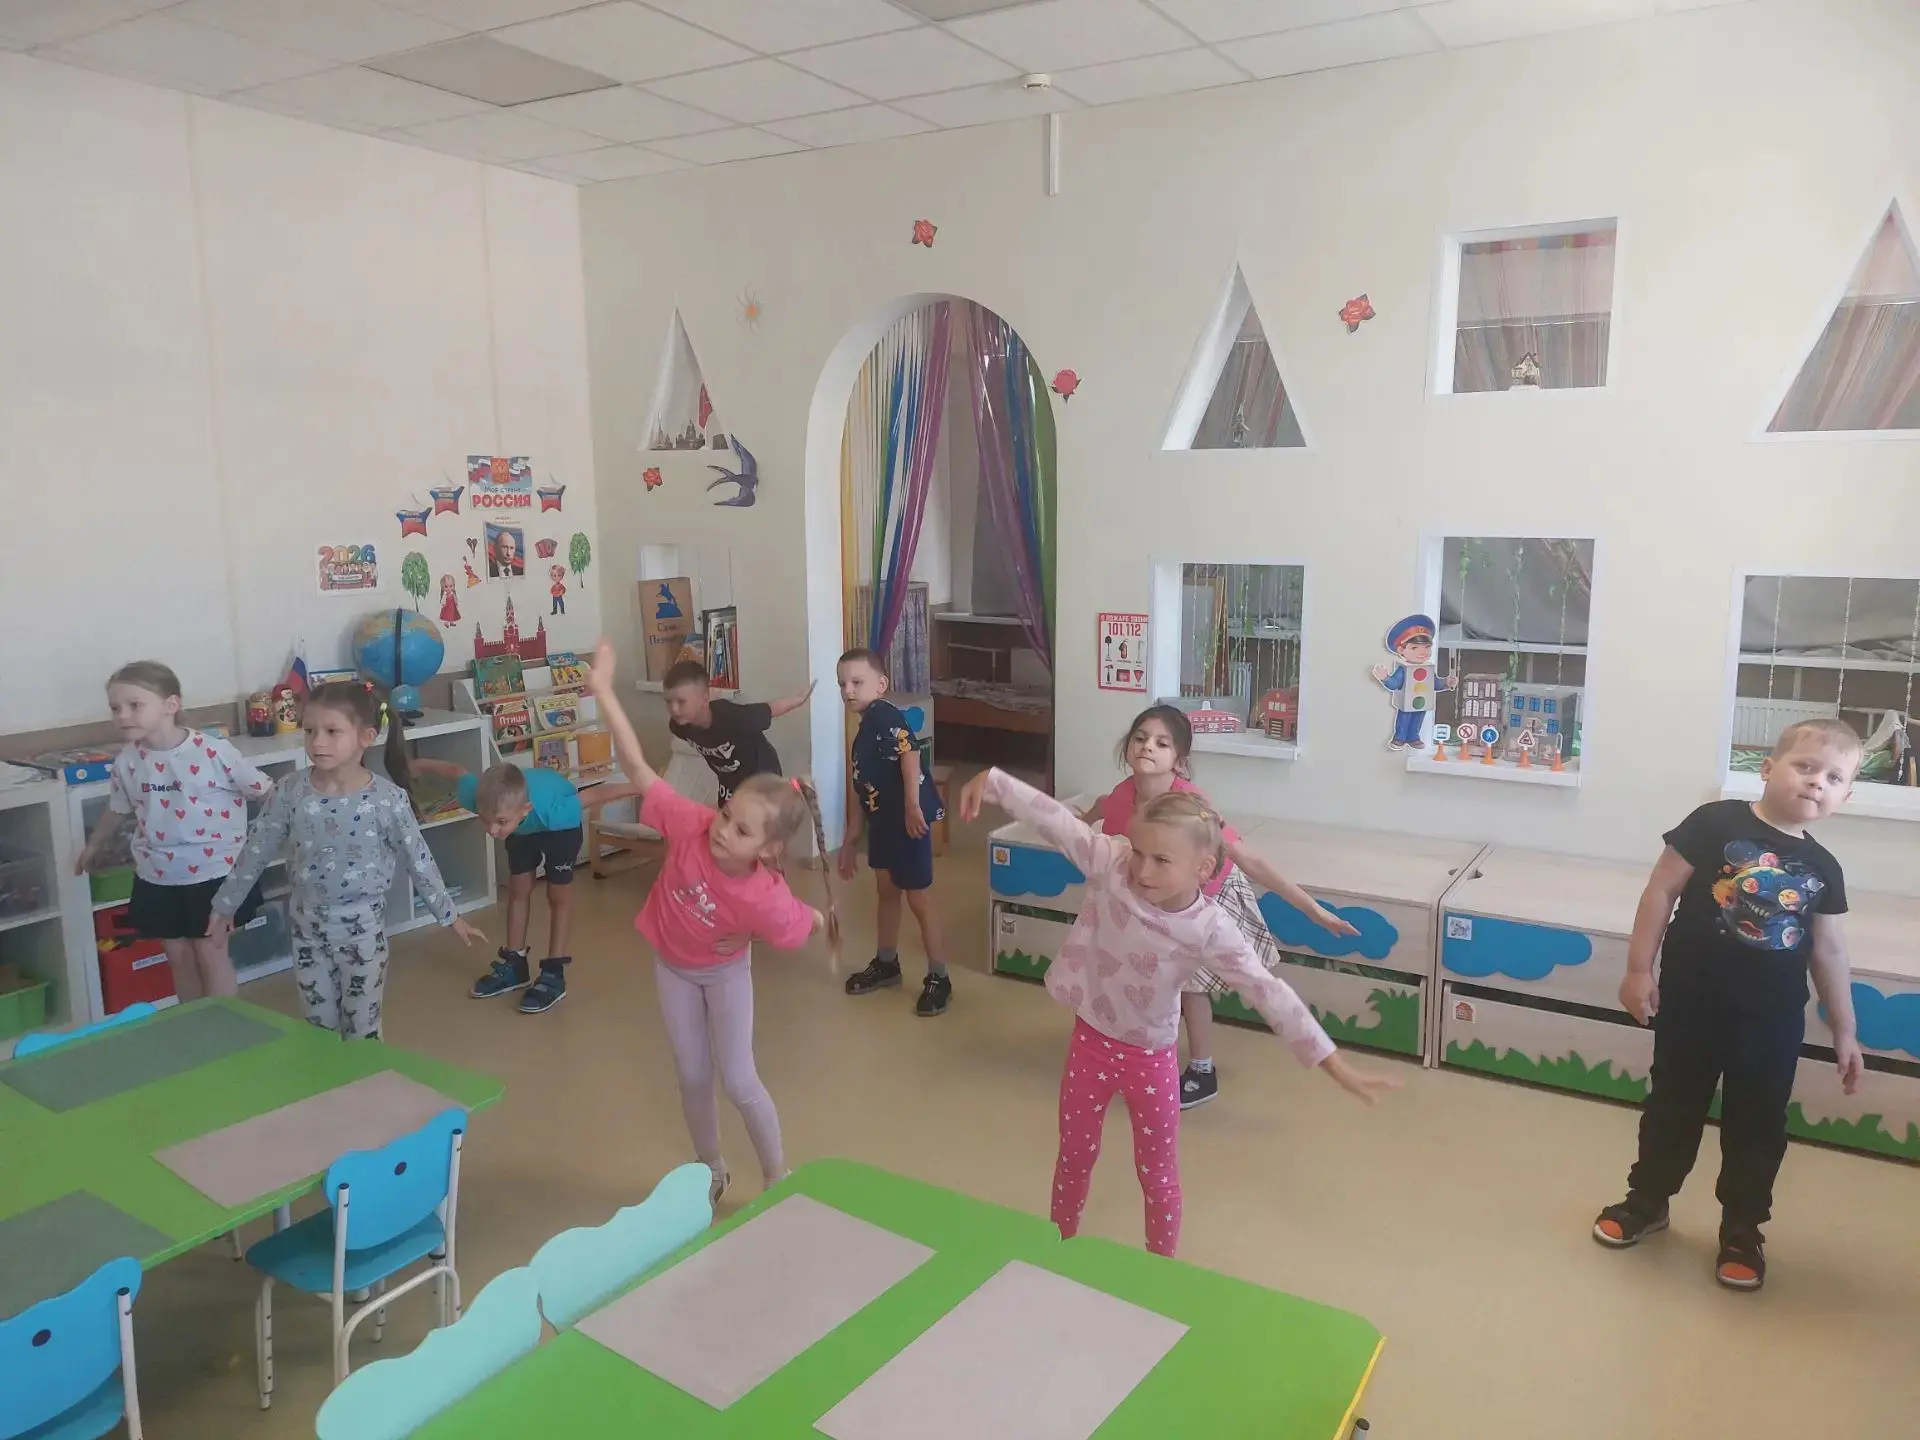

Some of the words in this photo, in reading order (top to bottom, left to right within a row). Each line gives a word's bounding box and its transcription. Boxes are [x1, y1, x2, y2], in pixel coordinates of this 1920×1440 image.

[472, 494, 531, 508] РОССИЯ
[318, 544, 376, 564] 2026
[1126, 623, 1141, 636] 112
